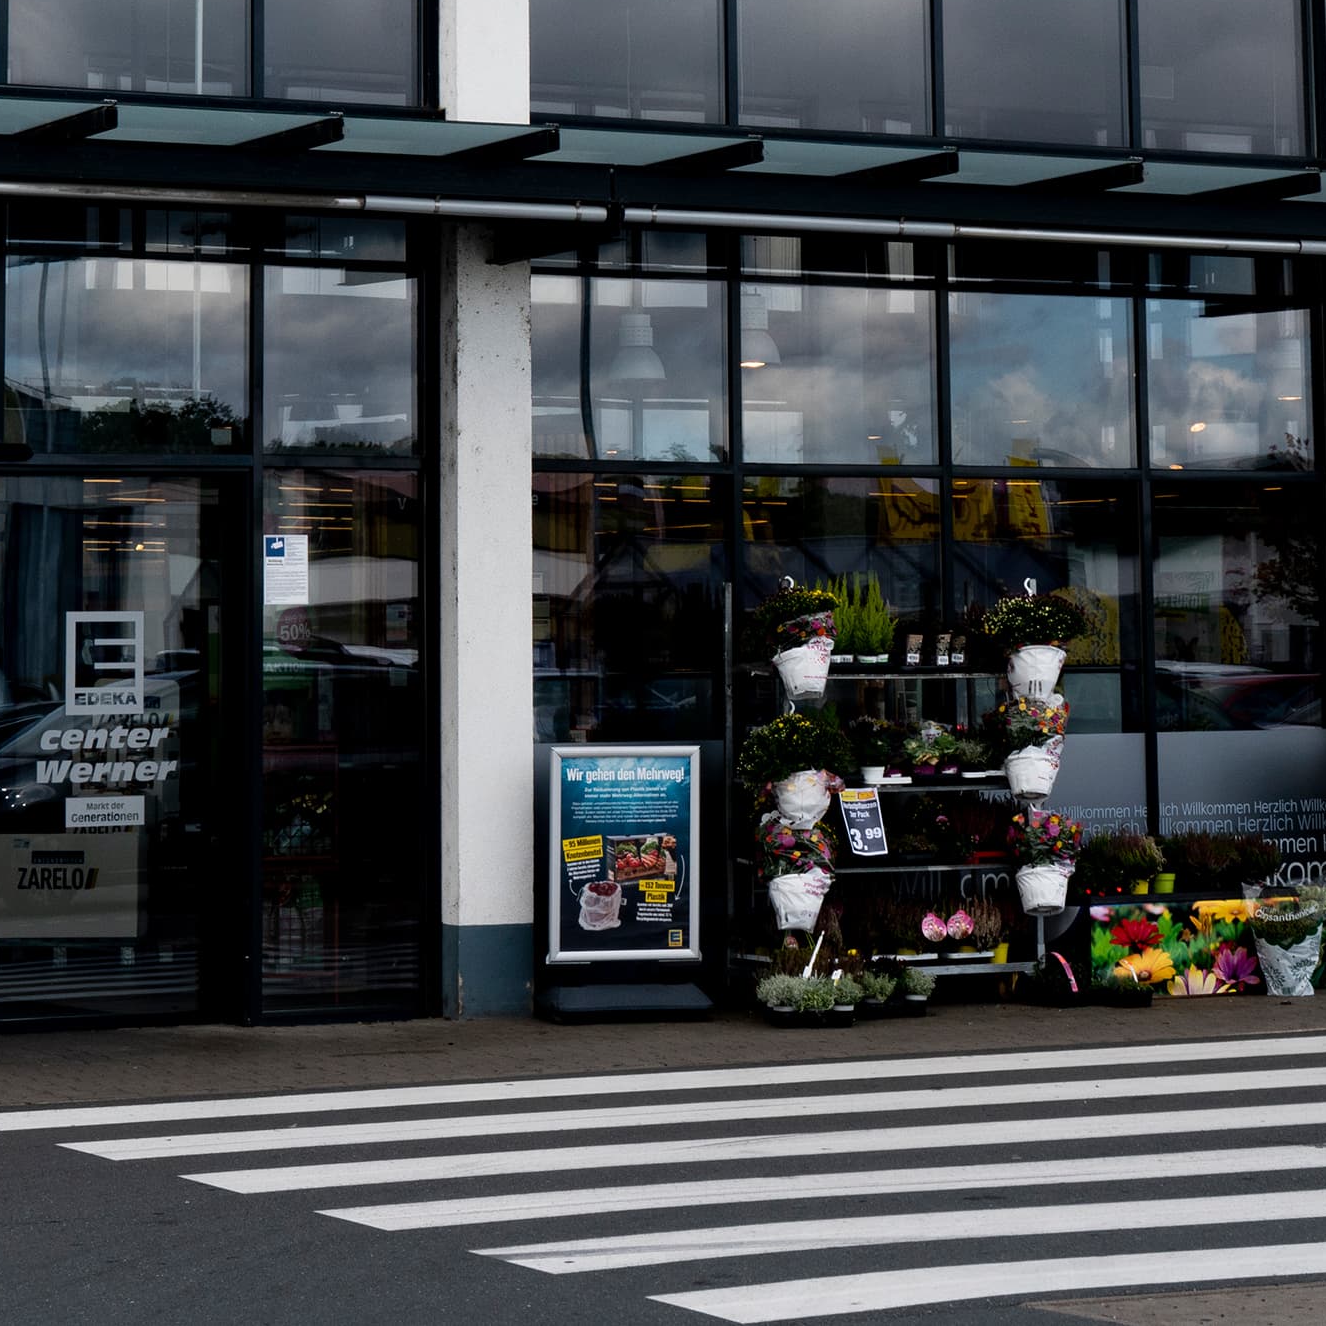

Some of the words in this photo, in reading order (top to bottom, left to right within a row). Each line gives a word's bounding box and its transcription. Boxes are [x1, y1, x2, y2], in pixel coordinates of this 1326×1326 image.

[280, 622, 311, 642] 50%
[74, 692, 137, 706] EDEKA
[39, 725, 170, 751] center
[35, 759, 178, 784] Werner
[566, 767, 584, 782] Wir
[585, 767, 615, 784] gehen
[617, 767, 636, 781] den
[637, 766, 685, 783] Mehrweg!
[86, 802, 110, 811] Markt
[110, 802, 125, 810] der
[1181, 801, 1251, 816] Willkommen
[1254, 798, 1298, 815] Herzlich
[71, 811, 140, 823] Generationen
[1237, 814, 1294, 832] Herzlich
[17, 867, 84, 890] ZARELO
